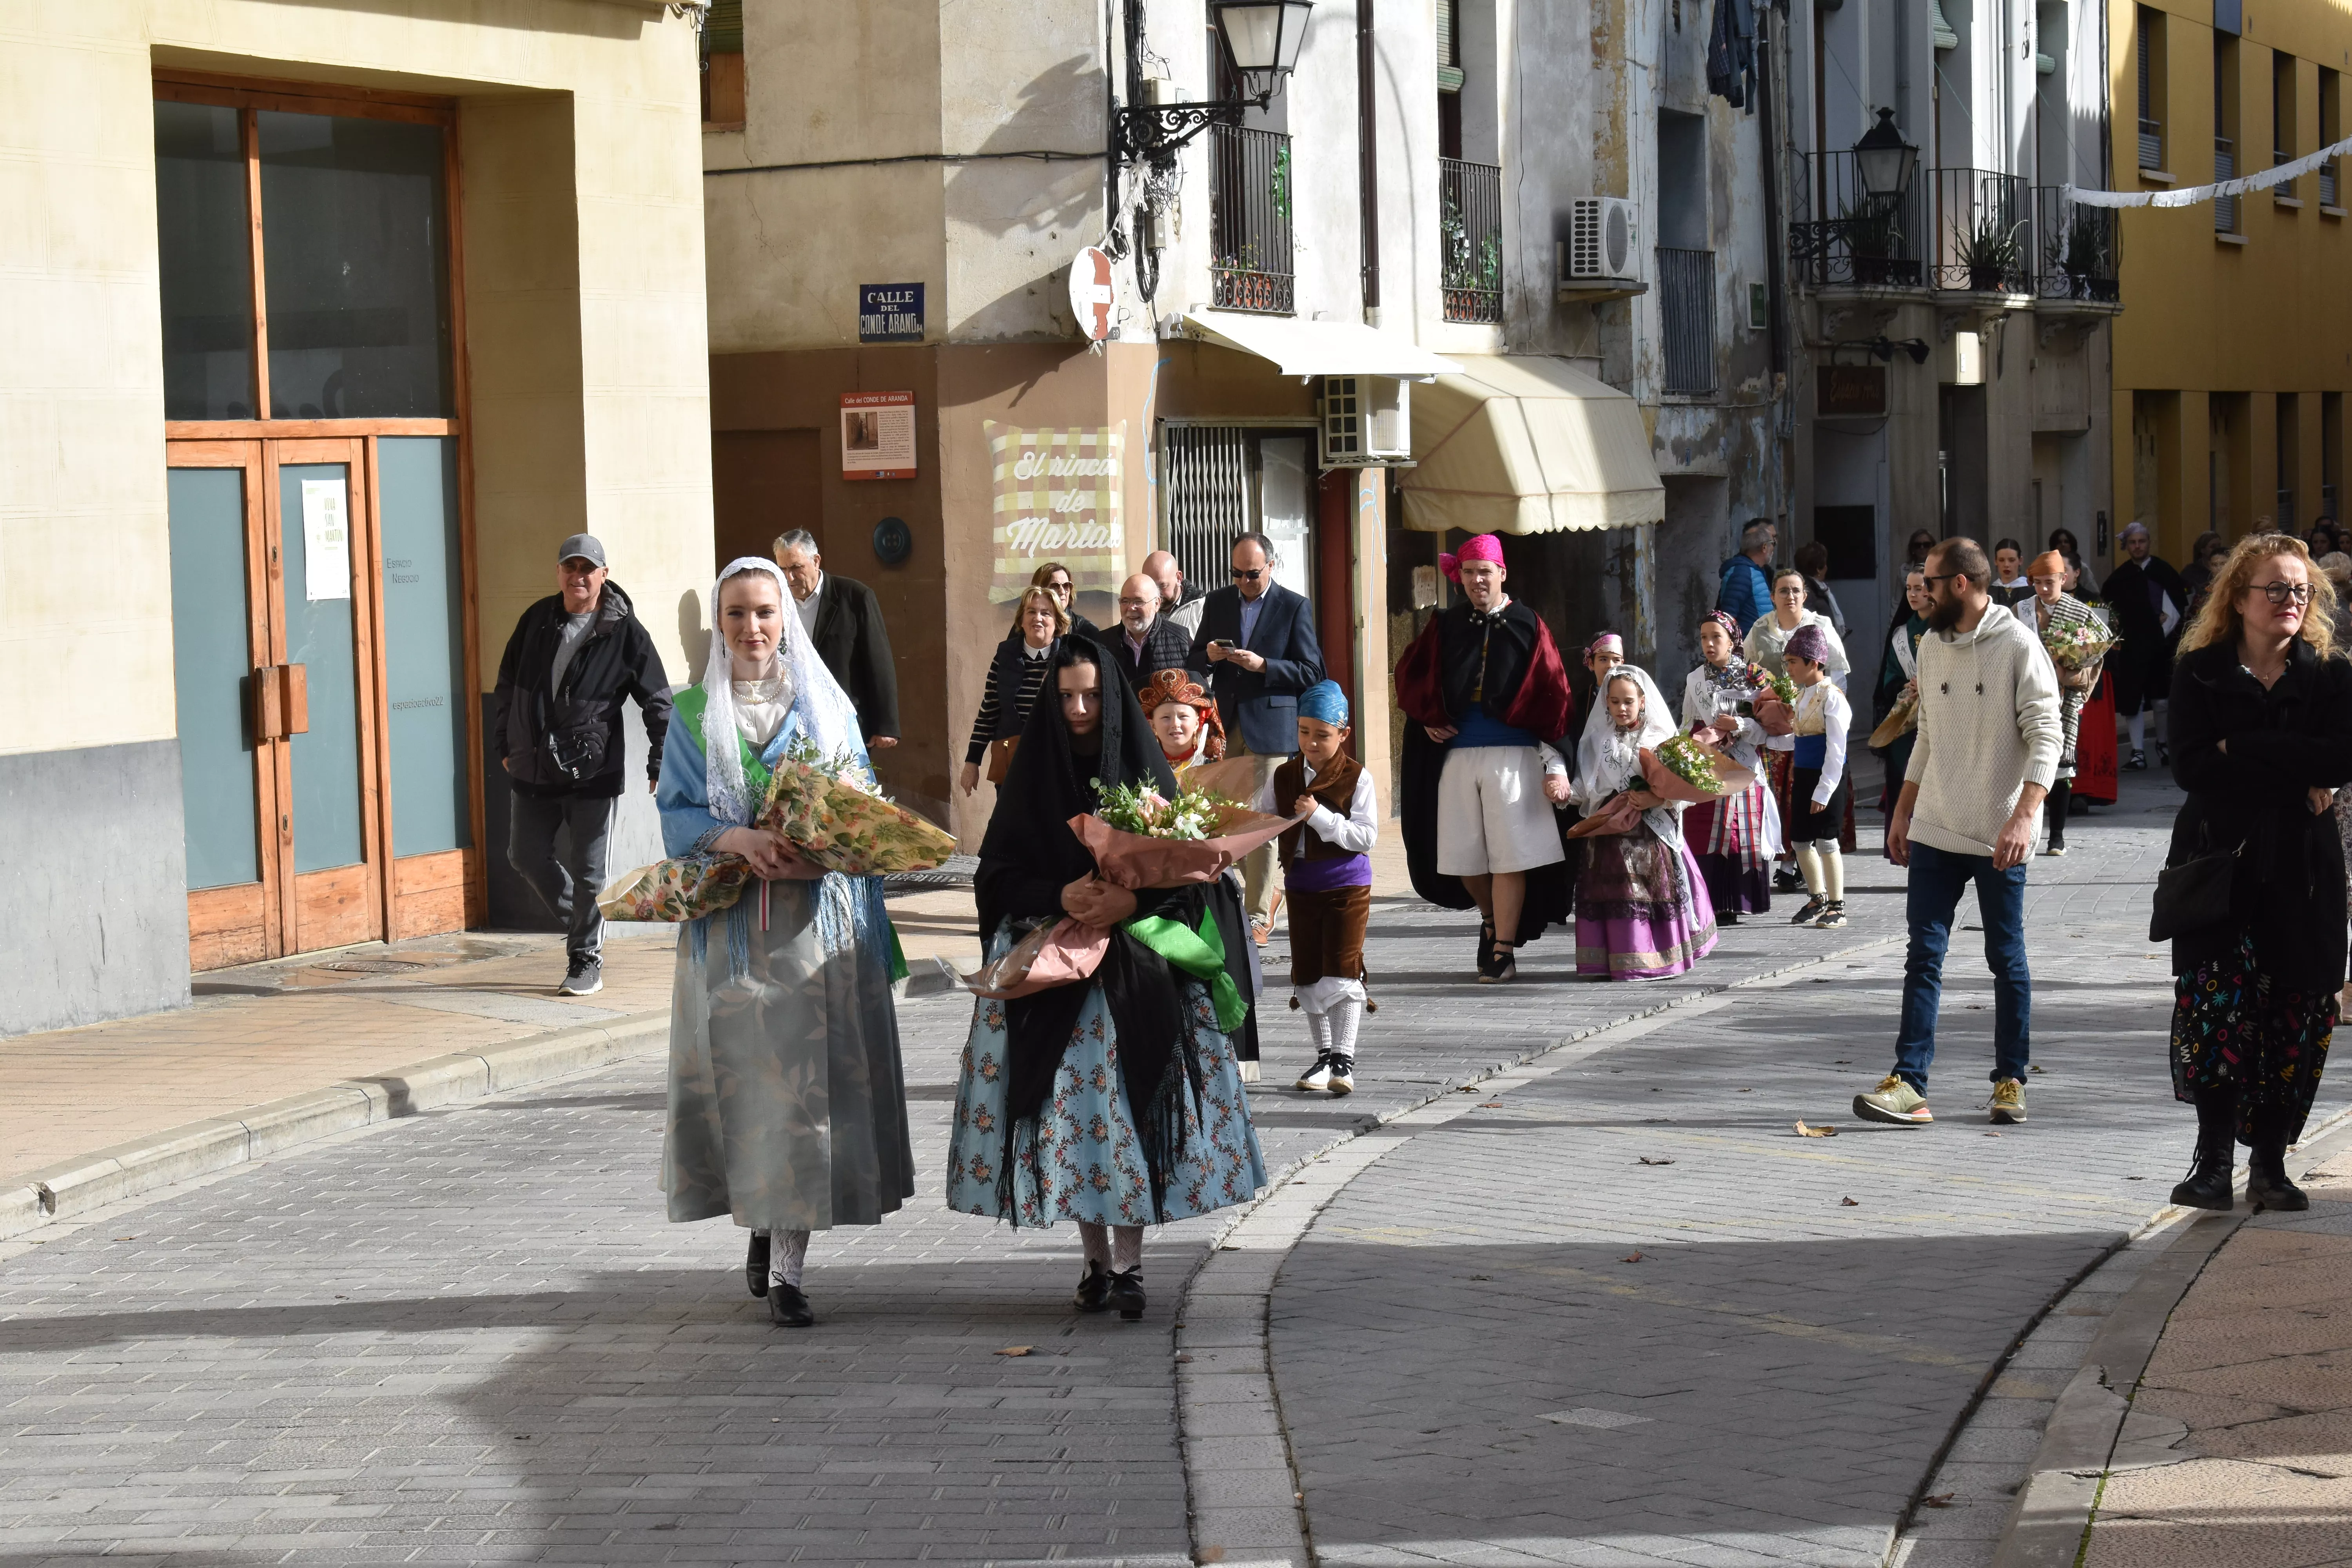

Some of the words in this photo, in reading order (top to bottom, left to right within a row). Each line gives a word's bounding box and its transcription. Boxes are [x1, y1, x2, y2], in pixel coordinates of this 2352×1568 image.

[867, 291, 913, 303] CALLE
[860, 314, 886, 334] CONDE
[1014, 451, 1047, 480] El
[1048, 453, 1117, 477] rincó
[324, 497, 336, 510] VIVA
[1055, 488, 1086, 513] de
[325, 514, 334, 526] SAN
[325, 527, 343, 542] MARTÍN
[393, 696, 444, 711] espacioactivo22
